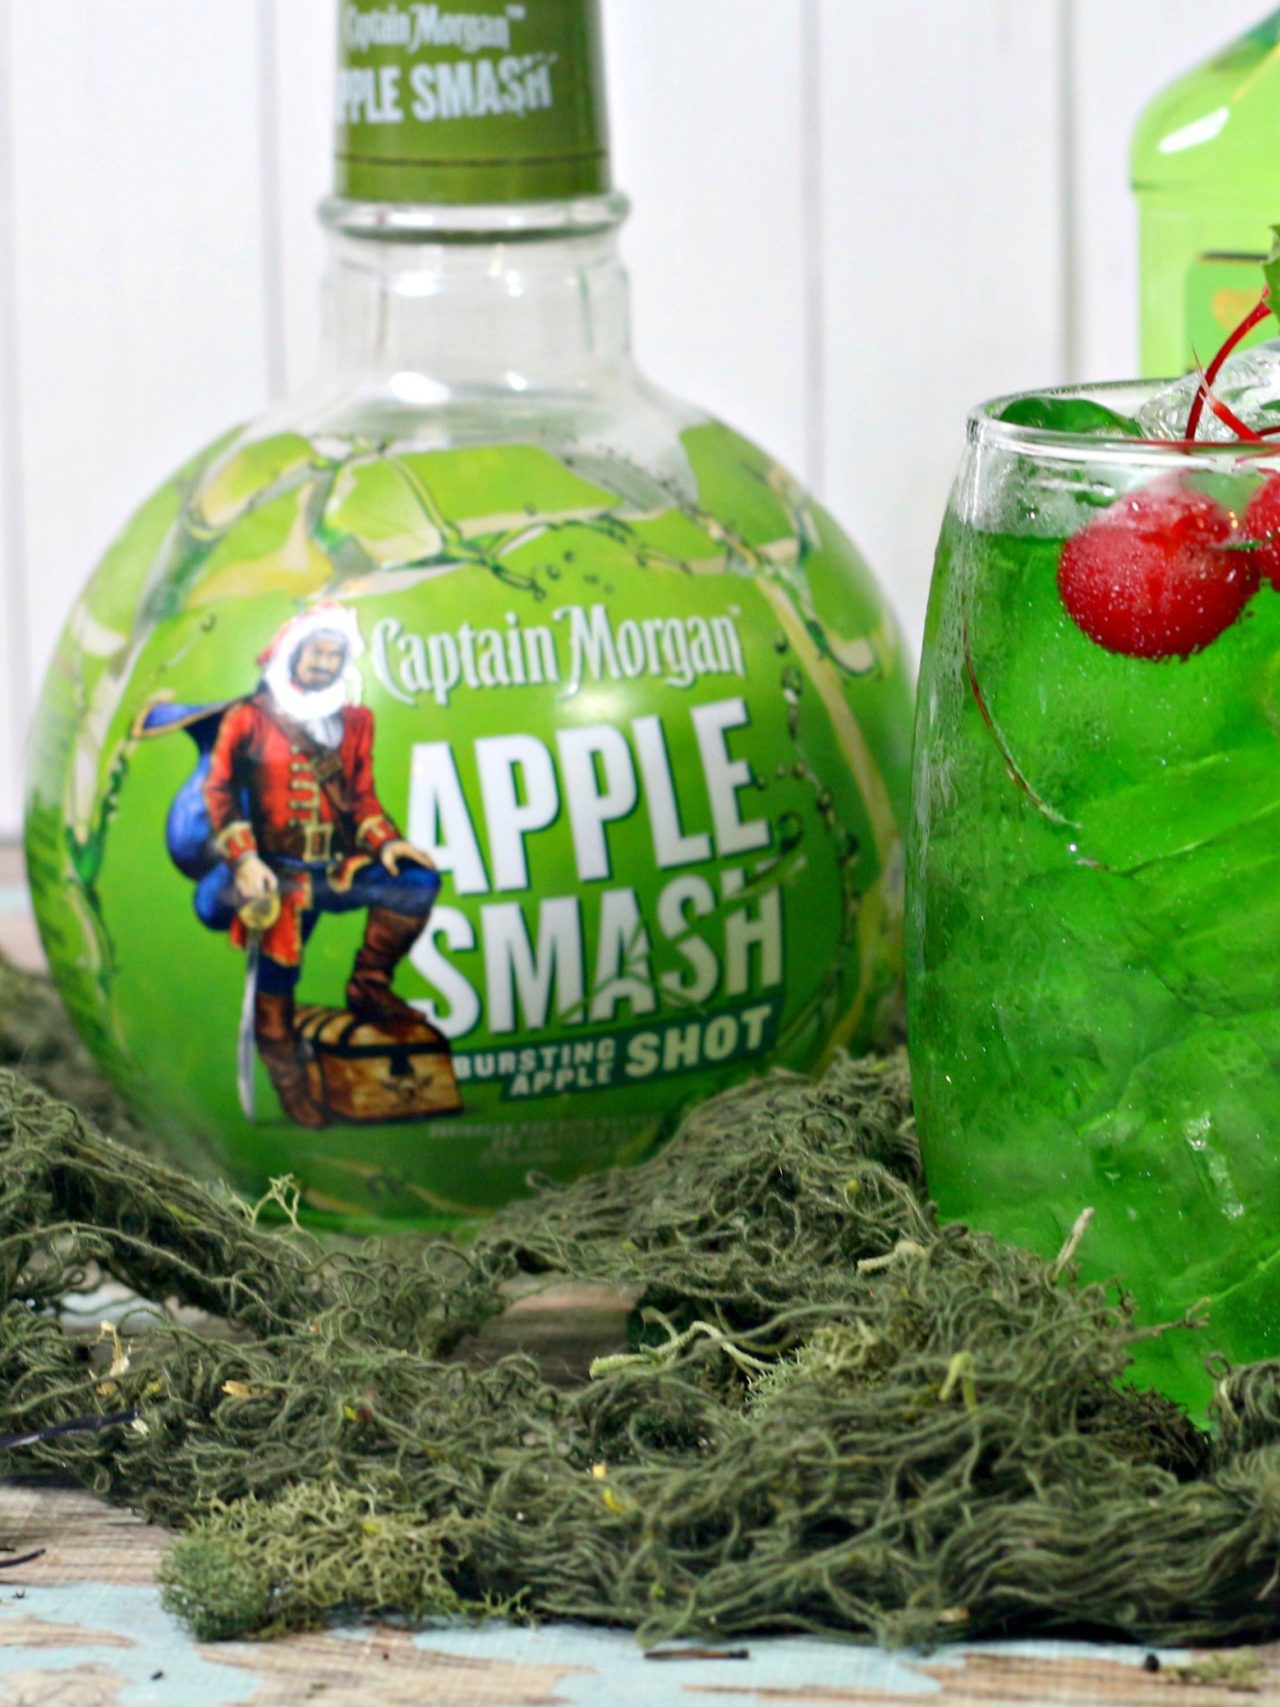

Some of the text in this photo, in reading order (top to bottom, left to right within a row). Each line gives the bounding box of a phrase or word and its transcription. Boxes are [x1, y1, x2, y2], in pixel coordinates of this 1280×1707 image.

[409, 54, 554, 122] SMASH
[372, 604, 746, 706] Captain Morgan
[407, 697, 770, 895] APPLE
[404, 861, 783, 1041] SMASH
[451, 1037, 616, 1079] BURSTING
[509, 1061, 614, 1097] APPLE
[624, 1004, 773, 1079] SHOT
